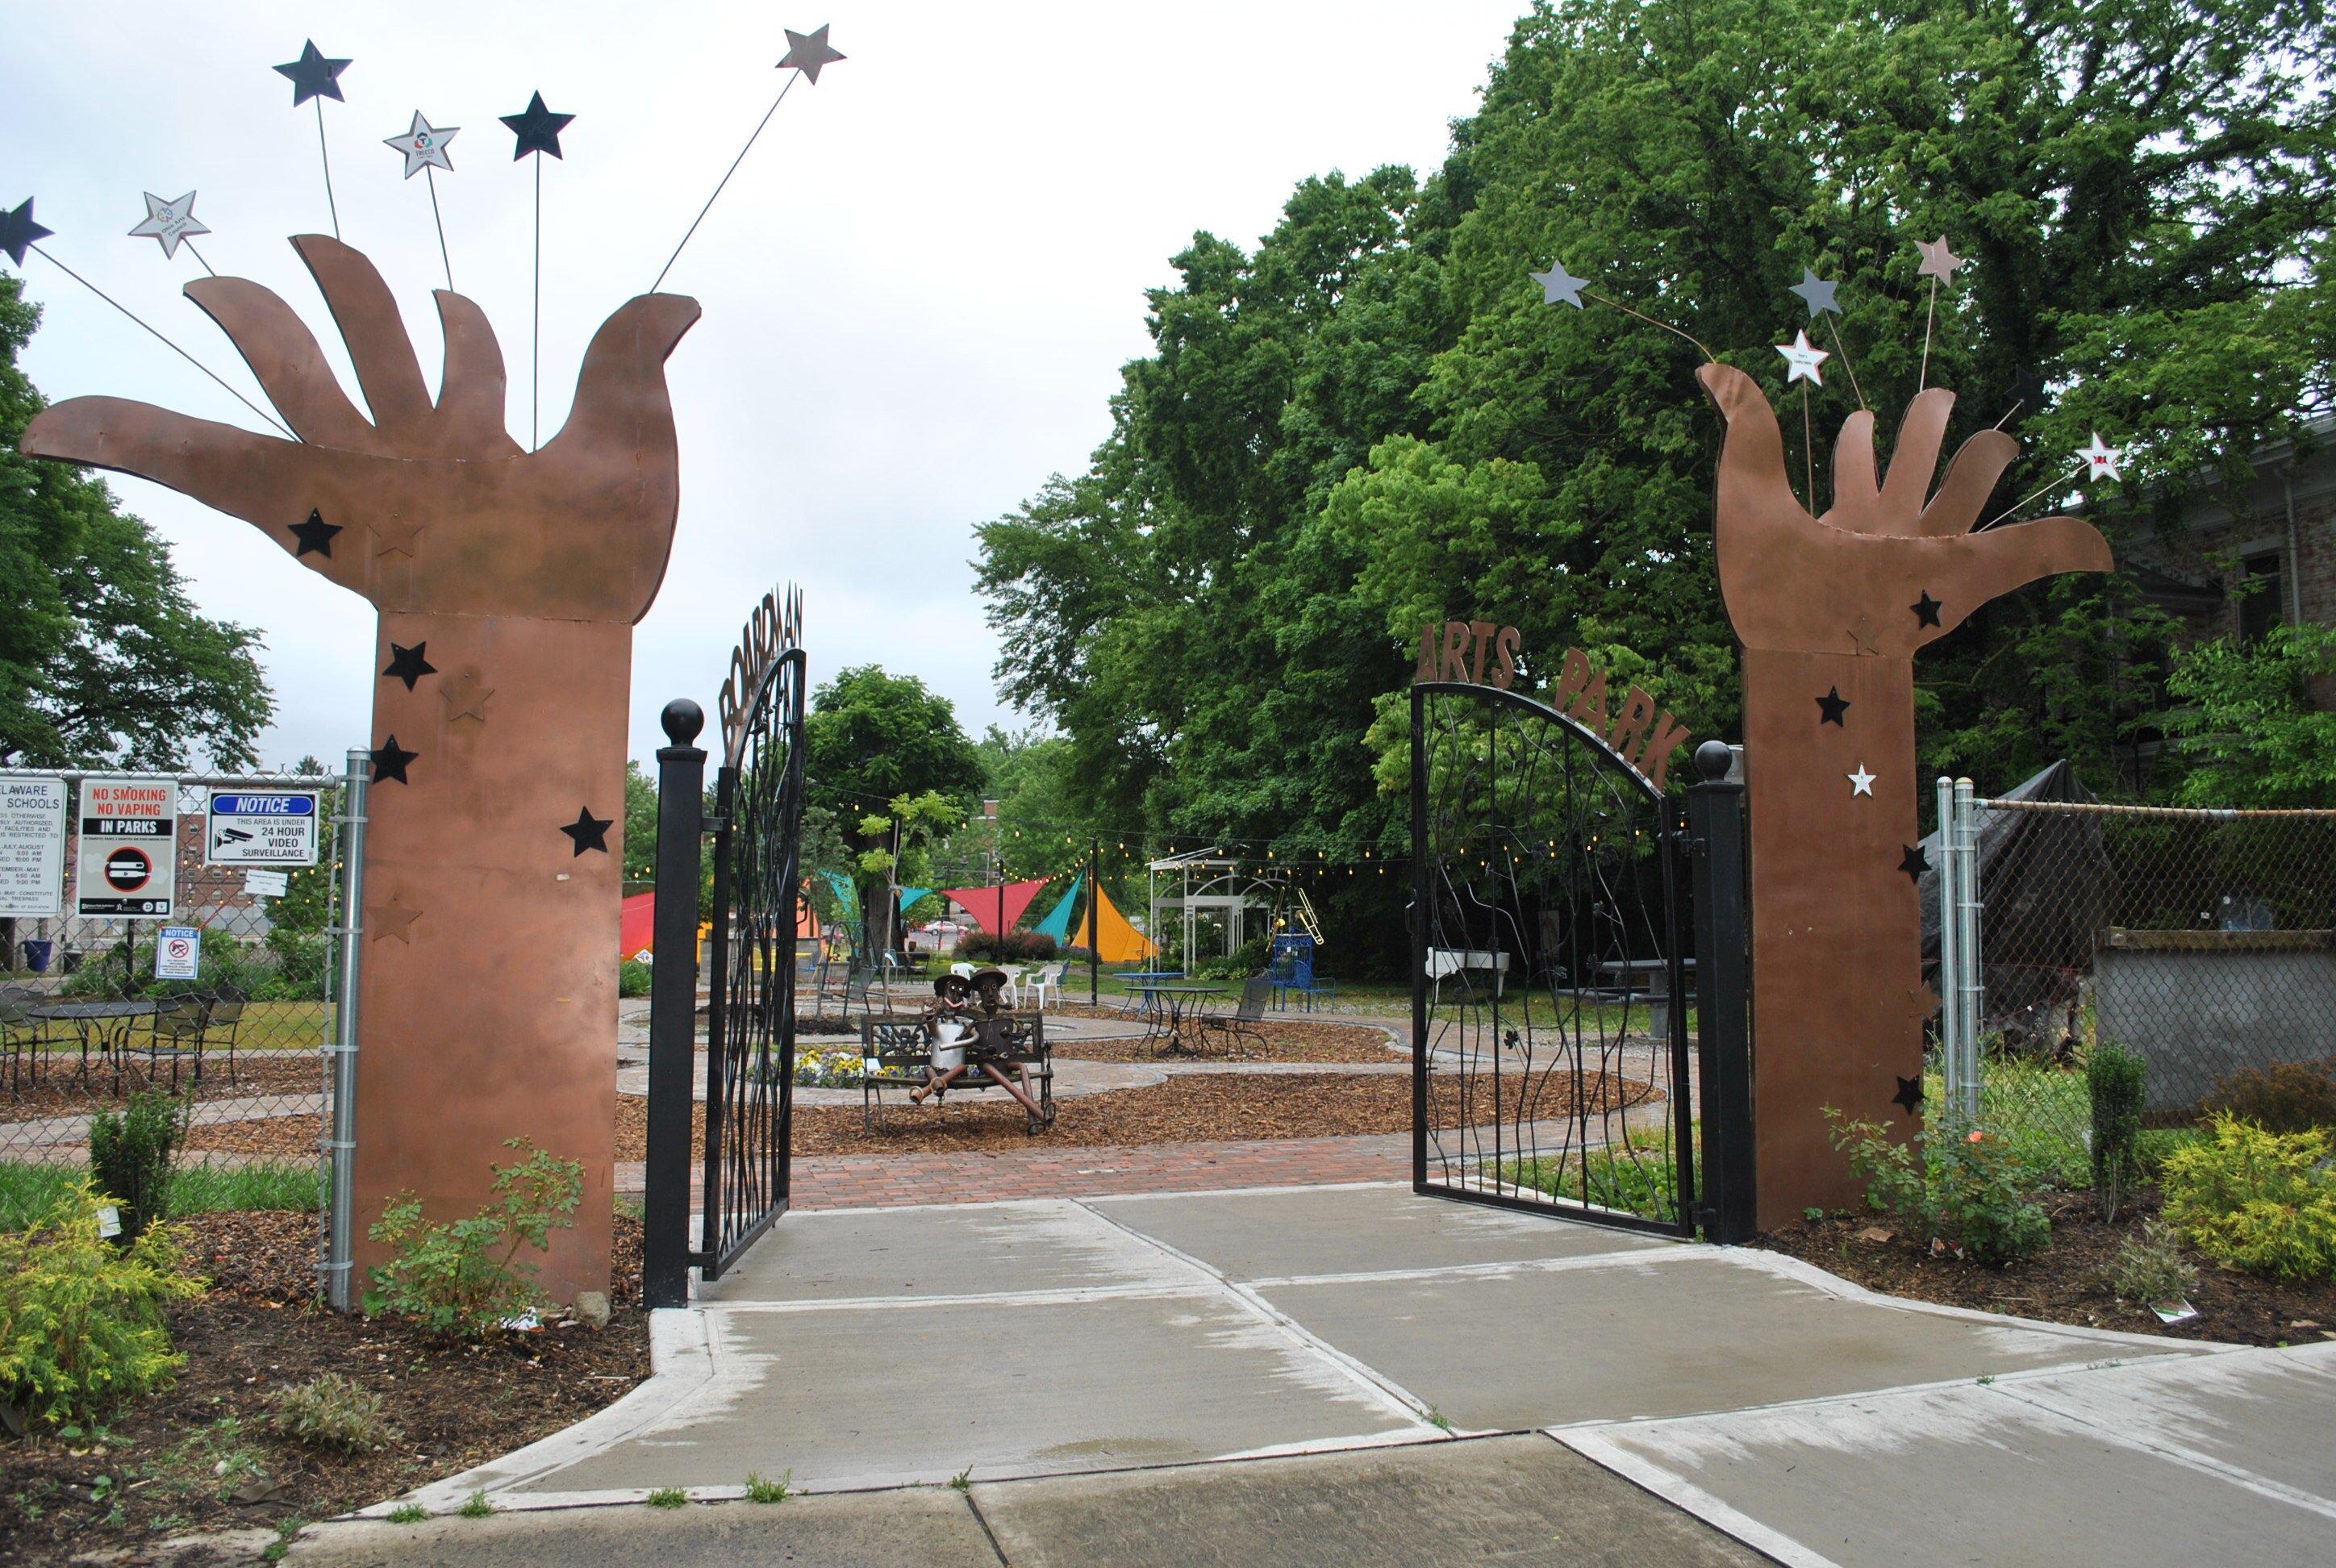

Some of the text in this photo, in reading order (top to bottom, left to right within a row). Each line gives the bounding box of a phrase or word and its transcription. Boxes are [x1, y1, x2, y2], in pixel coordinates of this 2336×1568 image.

[161, 216, 186, 233] Ohio Arts
[168, 222, 188, 236] Council
[719, 579, 803, 767] BOARDMAN
[1416, 621, 1692, 793] ARTS PARK
[0, 785, 48, 795] LAWARE
[93, 788, 166, 801] NO SMOKING
[7, 798, 60, 809] SCHOOLS
[97, 803, 161, 815] NO VAPING
[236, 797, 290, 813] NOTICE
[101, 820, 157, 834] IN PARKS
[261, 828, 305, 836] 24 HOUR
[268, 838, 298, 848] VIDEO
[242, 849, 305, 857] SURVEILLANCE
[165, 929, 194, 937] NOTICE
